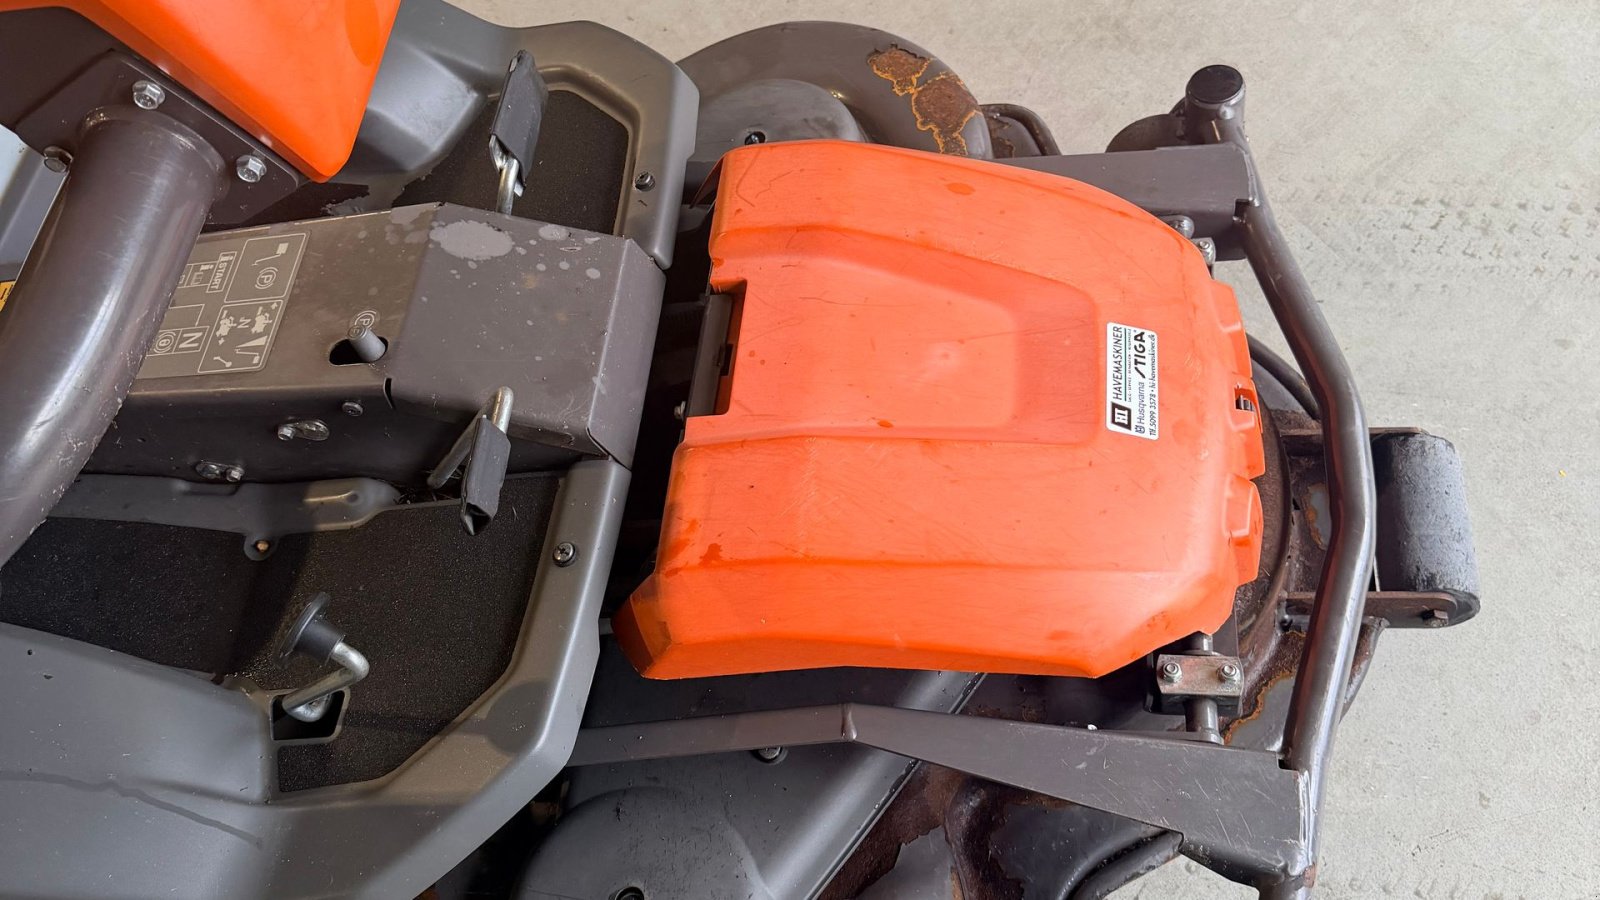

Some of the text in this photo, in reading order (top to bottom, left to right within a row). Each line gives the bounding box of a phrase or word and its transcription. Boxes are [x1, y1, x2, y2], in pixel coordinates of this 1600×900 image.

[211, 262, 227, 289] START
[237, 316, 252, 329] N
[179, 331, 203, 349] N
[1112, 326, 1123, 401] HAVEMASKINER
[1137, 381, 1147, 425] Husqvarna
[1149, 393, 1157, 410] 3578
